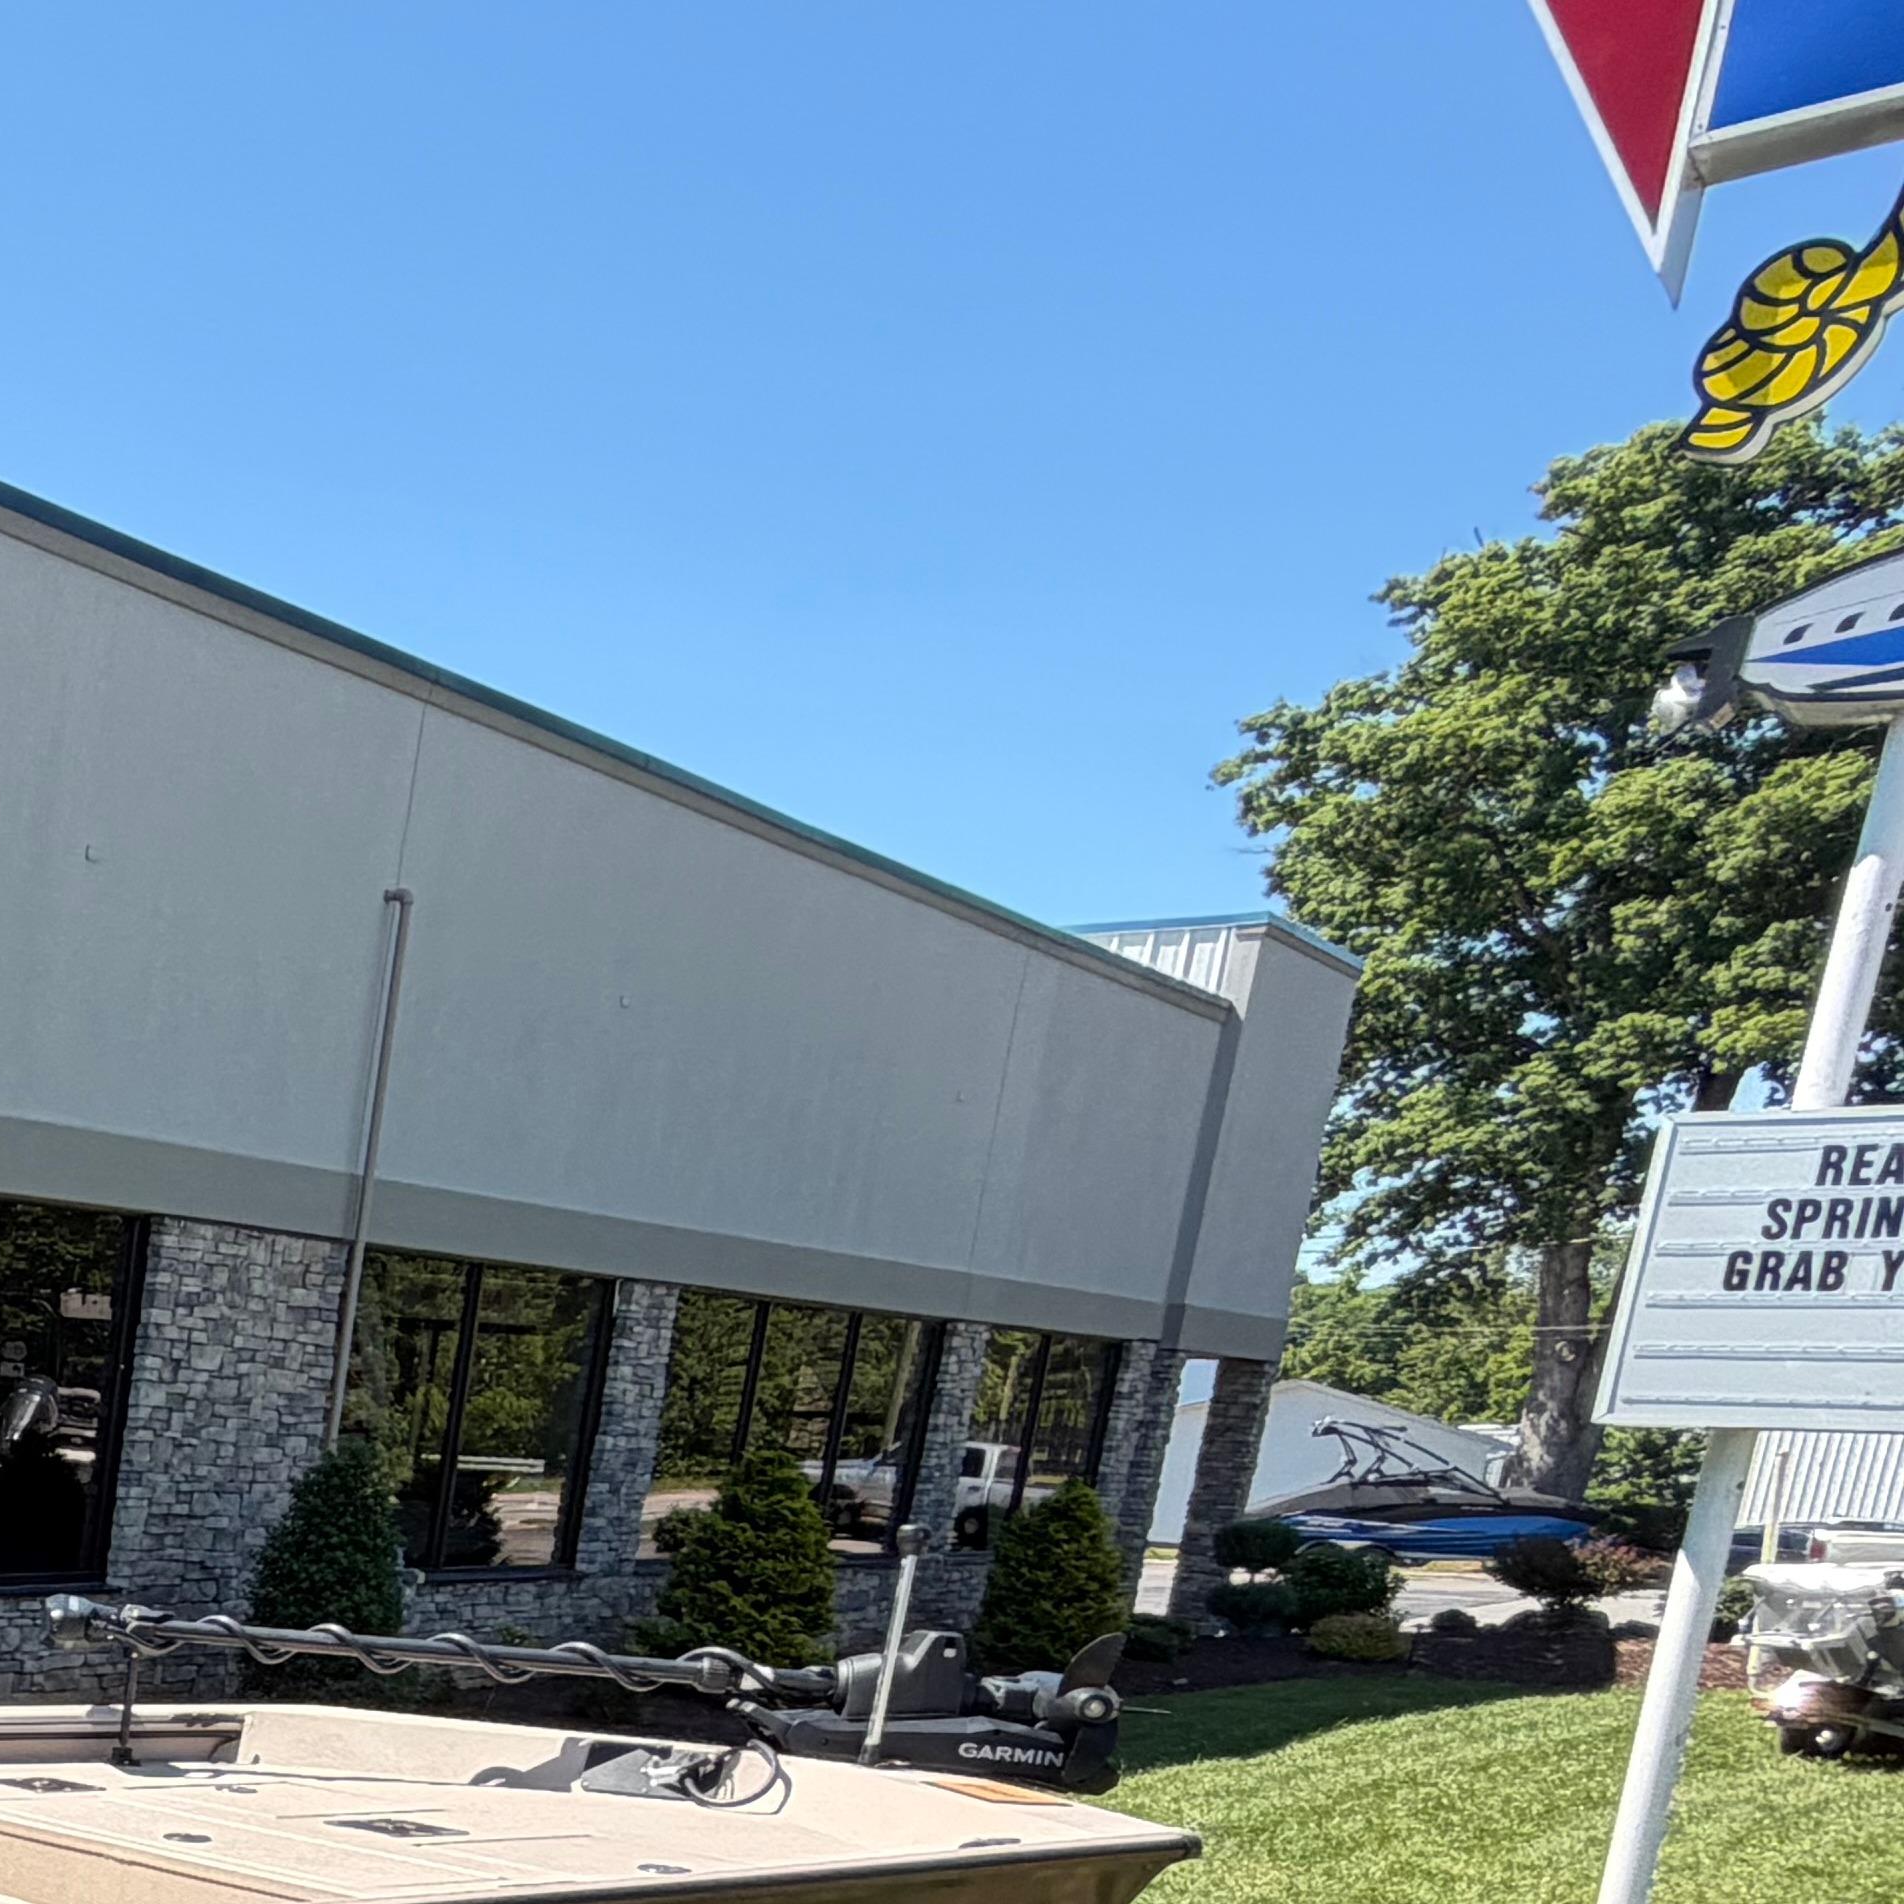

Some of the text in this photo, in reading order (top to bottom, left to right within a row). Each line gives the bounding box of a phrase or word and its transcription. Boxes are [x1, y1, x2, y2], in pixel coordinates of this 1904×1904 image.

[1814, 1143, 1904, 1186] REA
[1761, 1196, 1904, 1240] SPRIN
[1723, 1250, 1849, 1291] GRAB
[958, 1742, 1065, 1768] GARMIN
